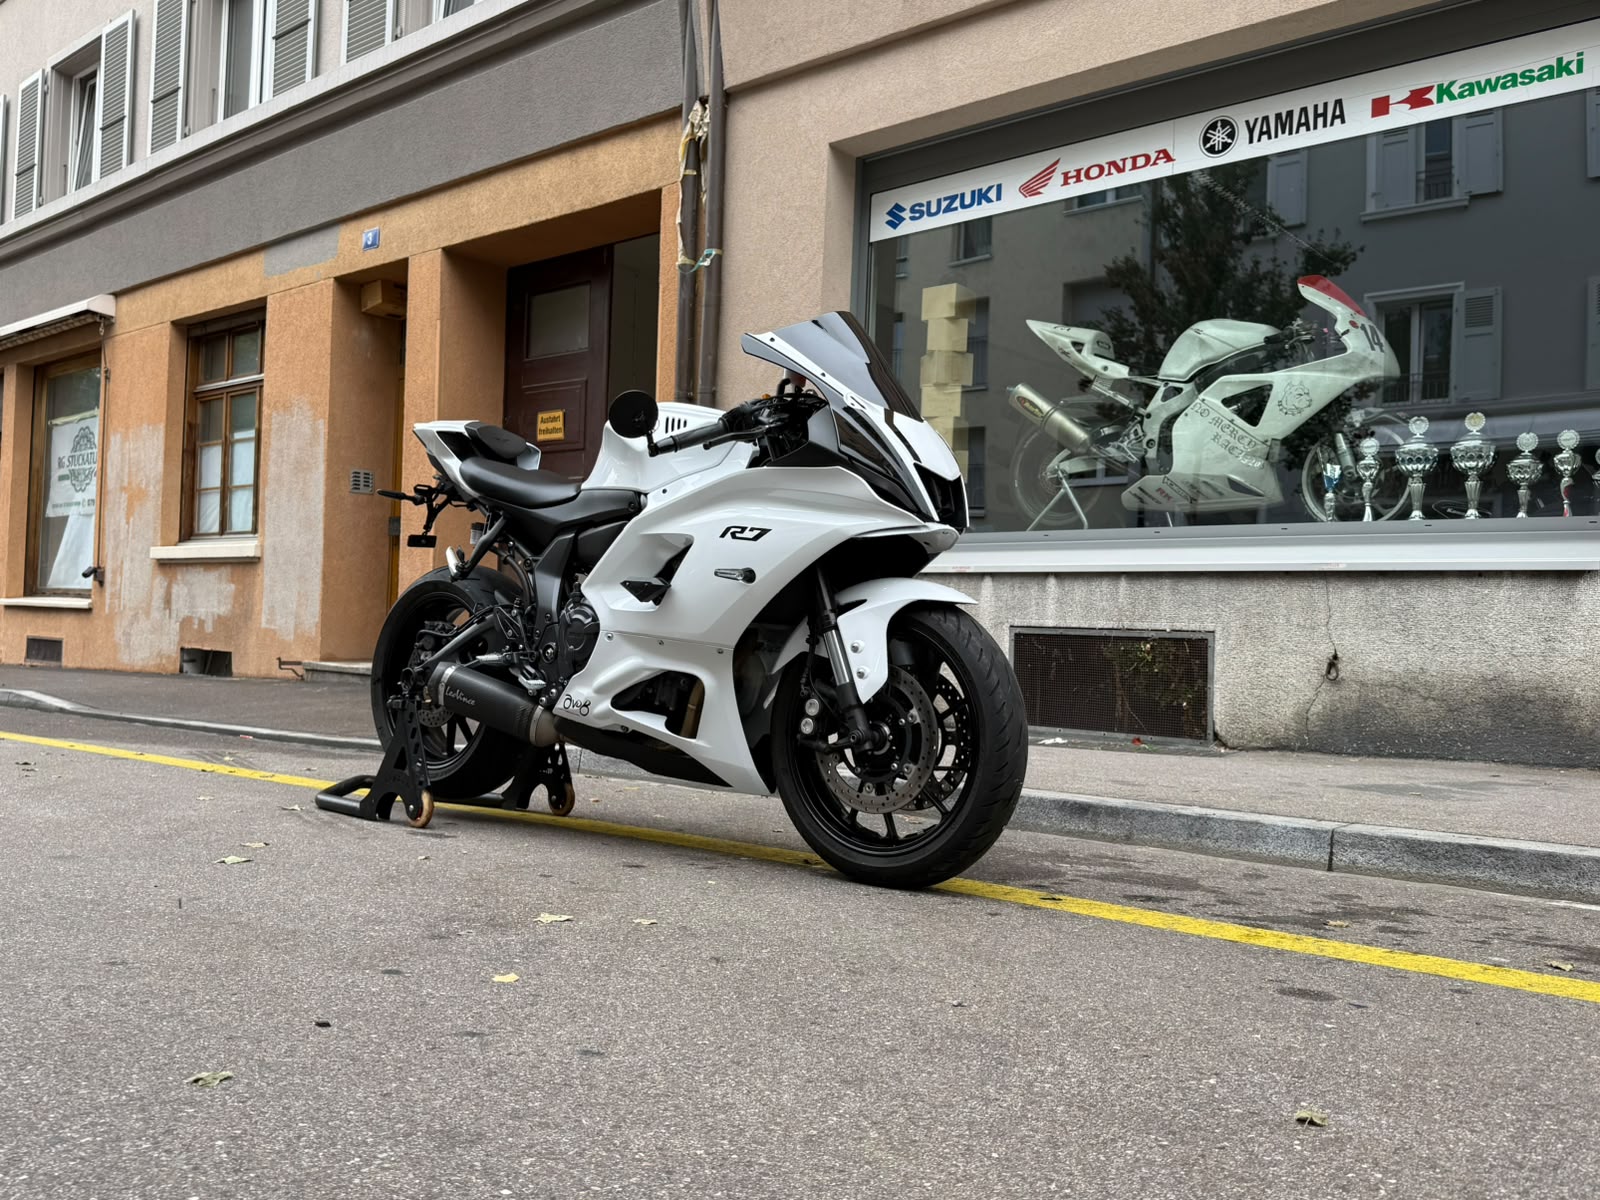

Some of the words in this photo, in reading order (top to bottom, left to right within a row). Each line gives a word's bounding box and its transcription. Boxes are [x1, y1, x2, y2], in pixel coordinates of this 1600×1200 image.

[908, 183, 1003, 221] SUZUKI
[1060, 148, 1176, 187] HONDA
[1244, 98, 1346, 145] YAMAHA
[1436, 51, 1585, 104] Kawasaki
[366, 231, 373, 245] 3
[1360, 323, 1385, 353] 14
[540, 415, 561, 424] Ausfahrt
[719, 525, 773, 542] R7
